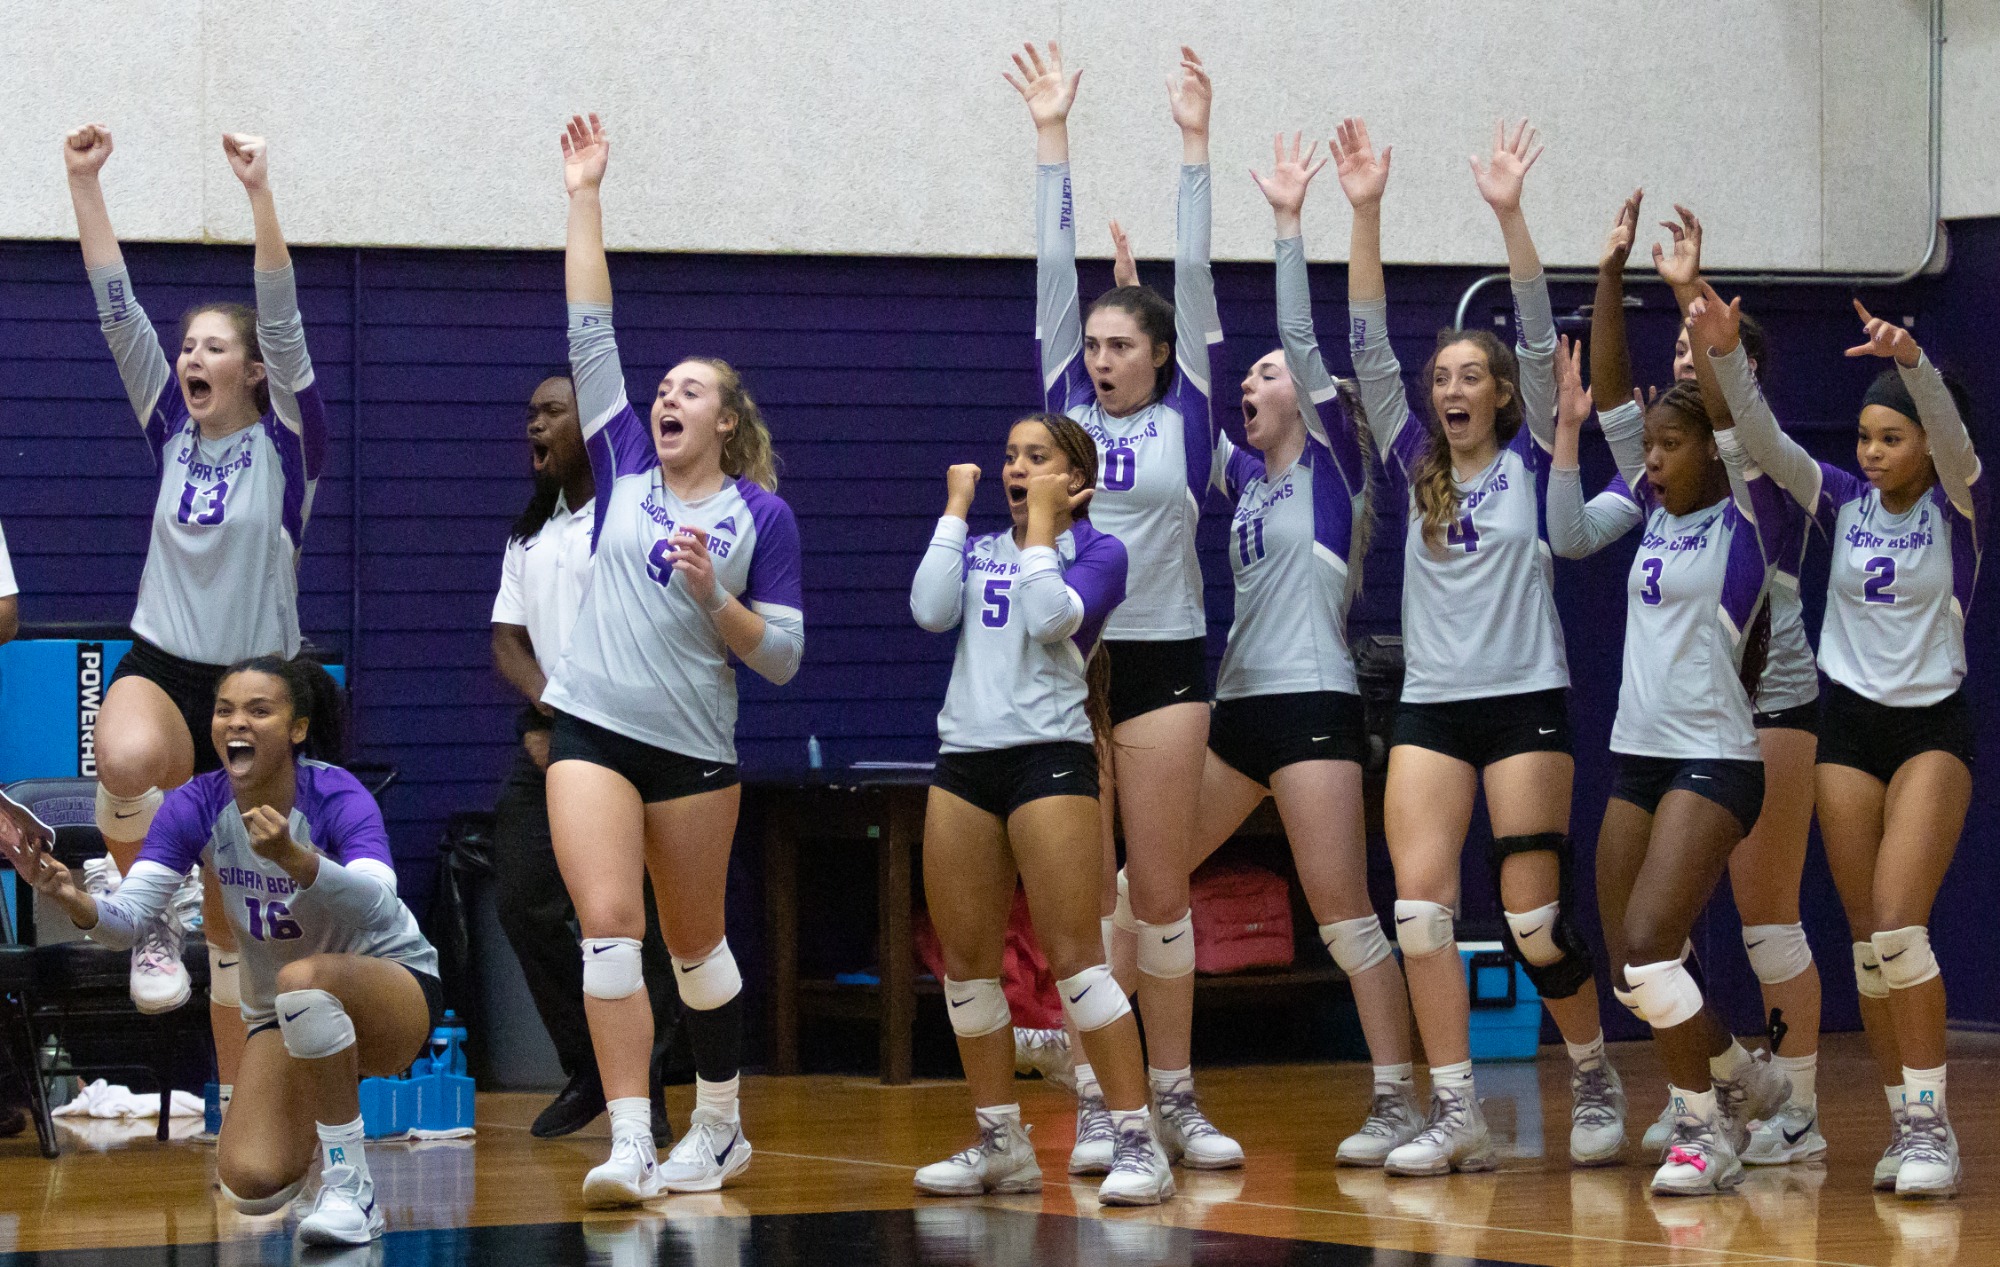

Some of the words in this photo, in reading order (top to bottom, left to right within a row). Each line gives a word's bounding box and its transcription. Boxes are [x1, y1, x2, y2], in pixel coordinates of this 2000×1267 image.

[1059, 177, 1073, 230] CENTRAL
[108, 280, 128, 322] CENT
[1083, 422, 1116, 450] UGAR
[1118, 421, 1158, 448] BES
[177, 447, 213, 482] SGAR
[177, 480, 230, 526] 13
[1467, 473, 1509, 509] BERS
[1236, 517, 1267, 568] 11
[1446, 513, 1480, 553] 4
[1641, 531, 1668, 551] GAR
[1668, 534, 1708, 551] EARS
[646, 538, 682, 588] 9
[1640, 556, 1664, 607] 3
[1863, 556, 1896, 605] 2
[981, 579, 1013, 629] 5
[81, 652, 101, 777] POWERAD
[266, 876, 299, 895] BEA
[244, 896, 304, 941] 16
